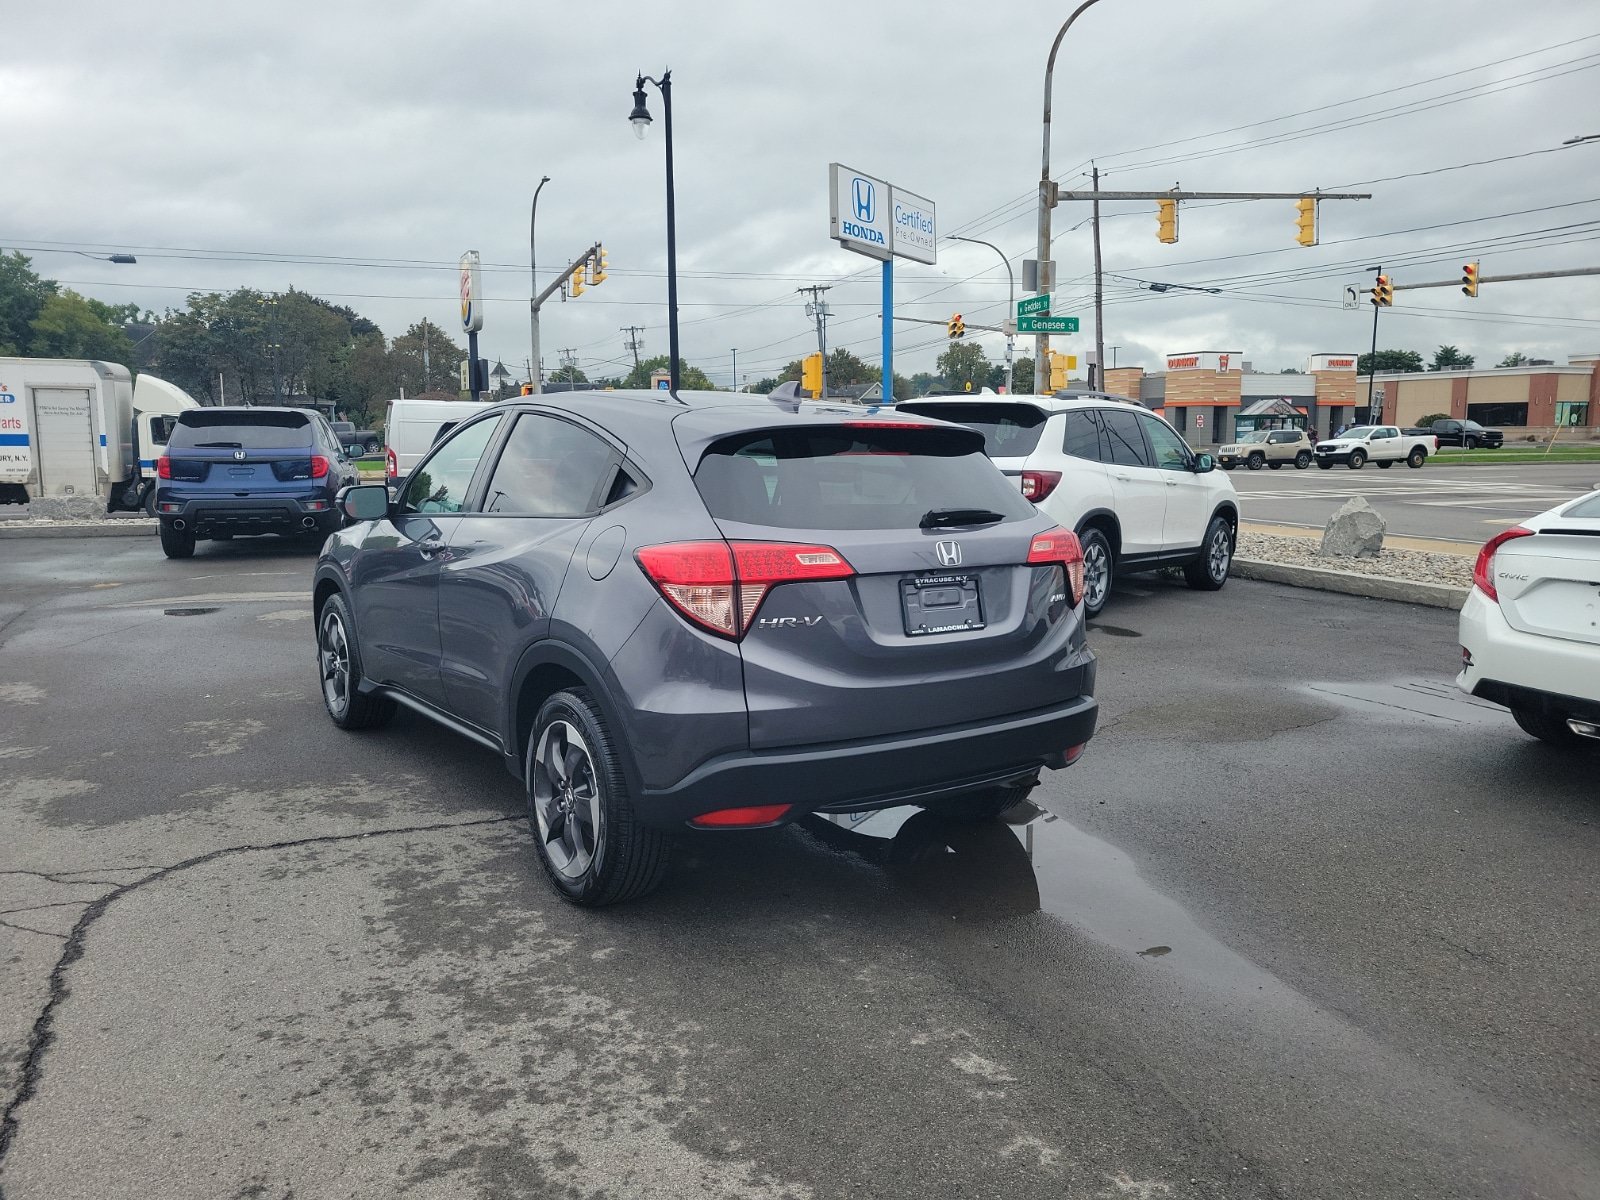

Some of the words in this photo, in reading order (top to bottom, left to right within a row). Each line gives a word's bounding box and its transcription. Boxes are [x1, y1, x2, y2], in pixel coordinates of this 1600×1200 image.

[895, 205, 933, 234] Certified
[843, 221, 885, 245] HONDA
[895, 227, 933, 248] Pre-Owned
[1032, 320, 1065, 329] Genesee
[0, 417, 21, 429] arts
[1499, 572, 1528, 581] CIVIC
[759, 615, 823, 629] HR-V
